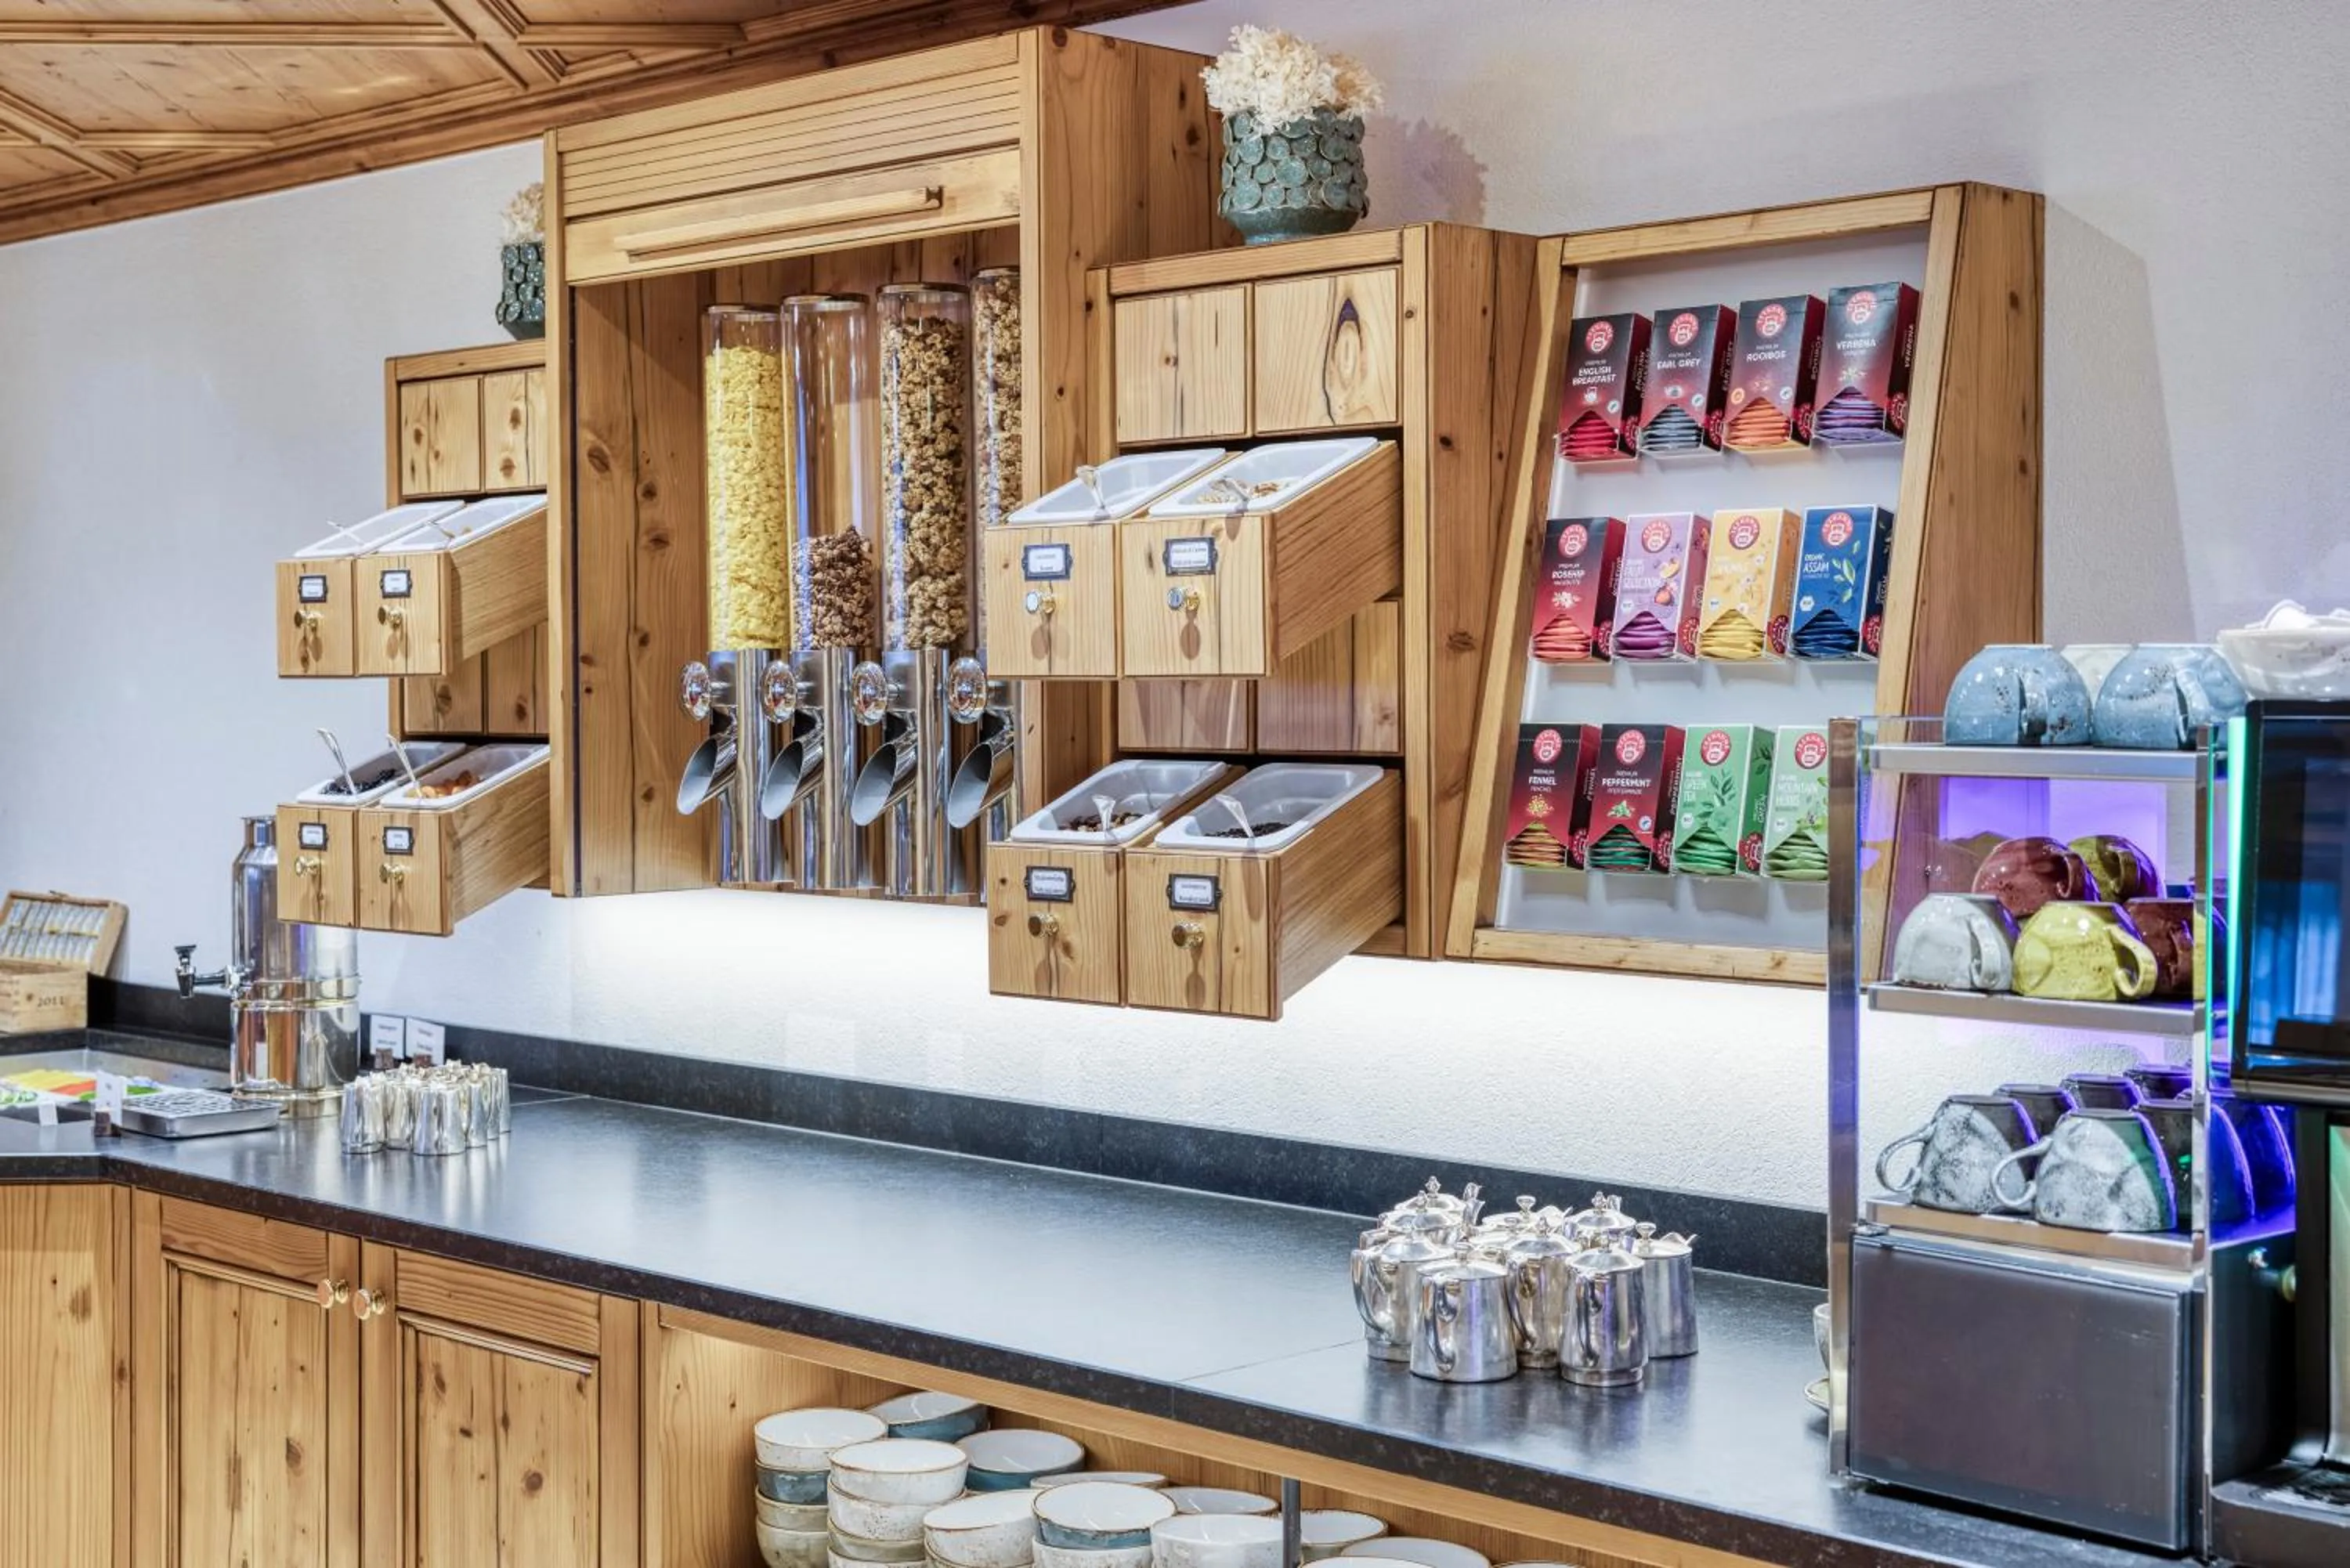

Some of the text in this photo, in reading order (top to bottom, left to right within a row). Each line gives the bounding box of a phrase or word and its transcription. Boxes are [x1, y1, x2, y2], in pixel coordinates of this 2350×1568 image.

[1657, 359, 1701, 370] EARL GREY
[1578, 367, 1611, 377] ENGLISH
[1572, 374, 1617, 387] BREAKFAST
[1802, 562, 1830, 573] ASSAM
[1552, 570, 1585, 579] ROSEHIP
[1602, 778, 1652, 787] PEPPERMINT
